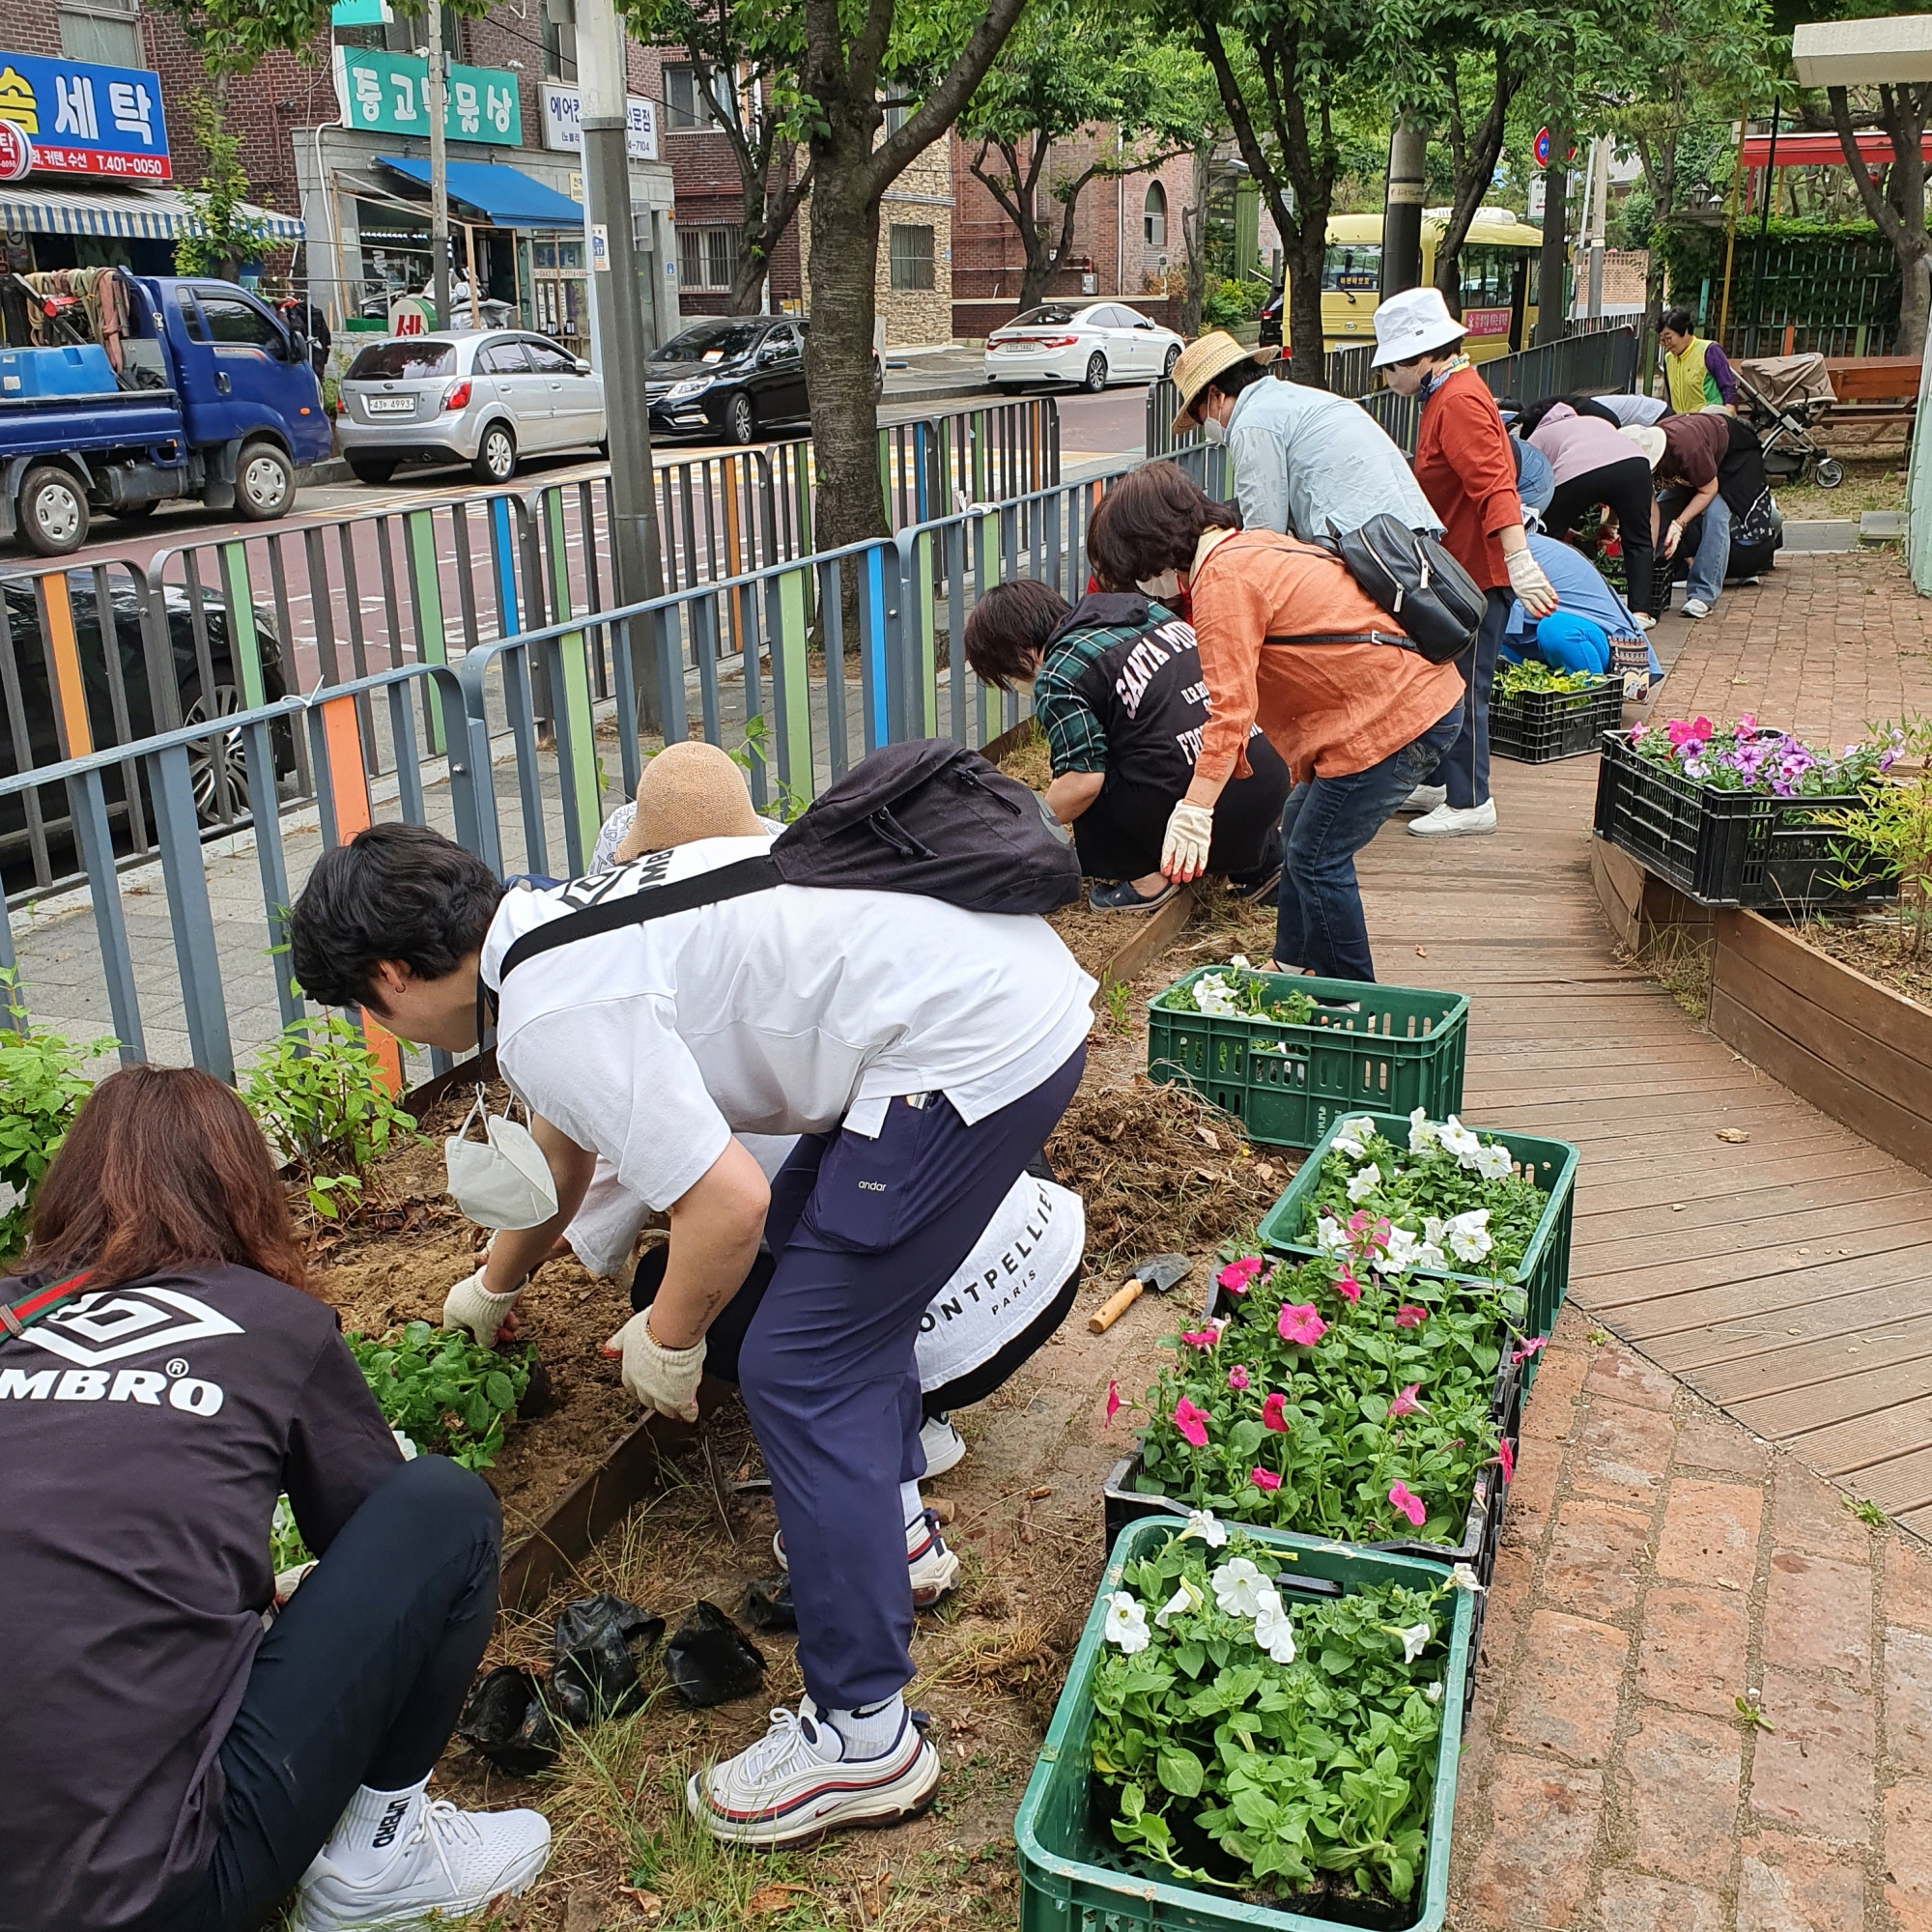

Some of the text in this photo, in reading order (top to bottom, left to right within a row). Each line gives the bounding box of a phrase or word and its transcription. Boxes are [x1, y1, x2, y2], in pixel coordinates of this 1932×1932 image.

[55, 75, 153, 145] 세탁
[68, 153, 88, 168] 수선
[97, 155, 162, 175] T.401-0050
[395, 314, 421, 337] 세
[390, 399, 411, 409] 4993
[1116, 638, 1171, 720] SANTA
[638, 850, 674, 894] MB
[859, 1180, 887, 1191] andar
[991, 1269, 1037, 1315] PARIS
[372, 1795, 412, 1848] UMBRO
